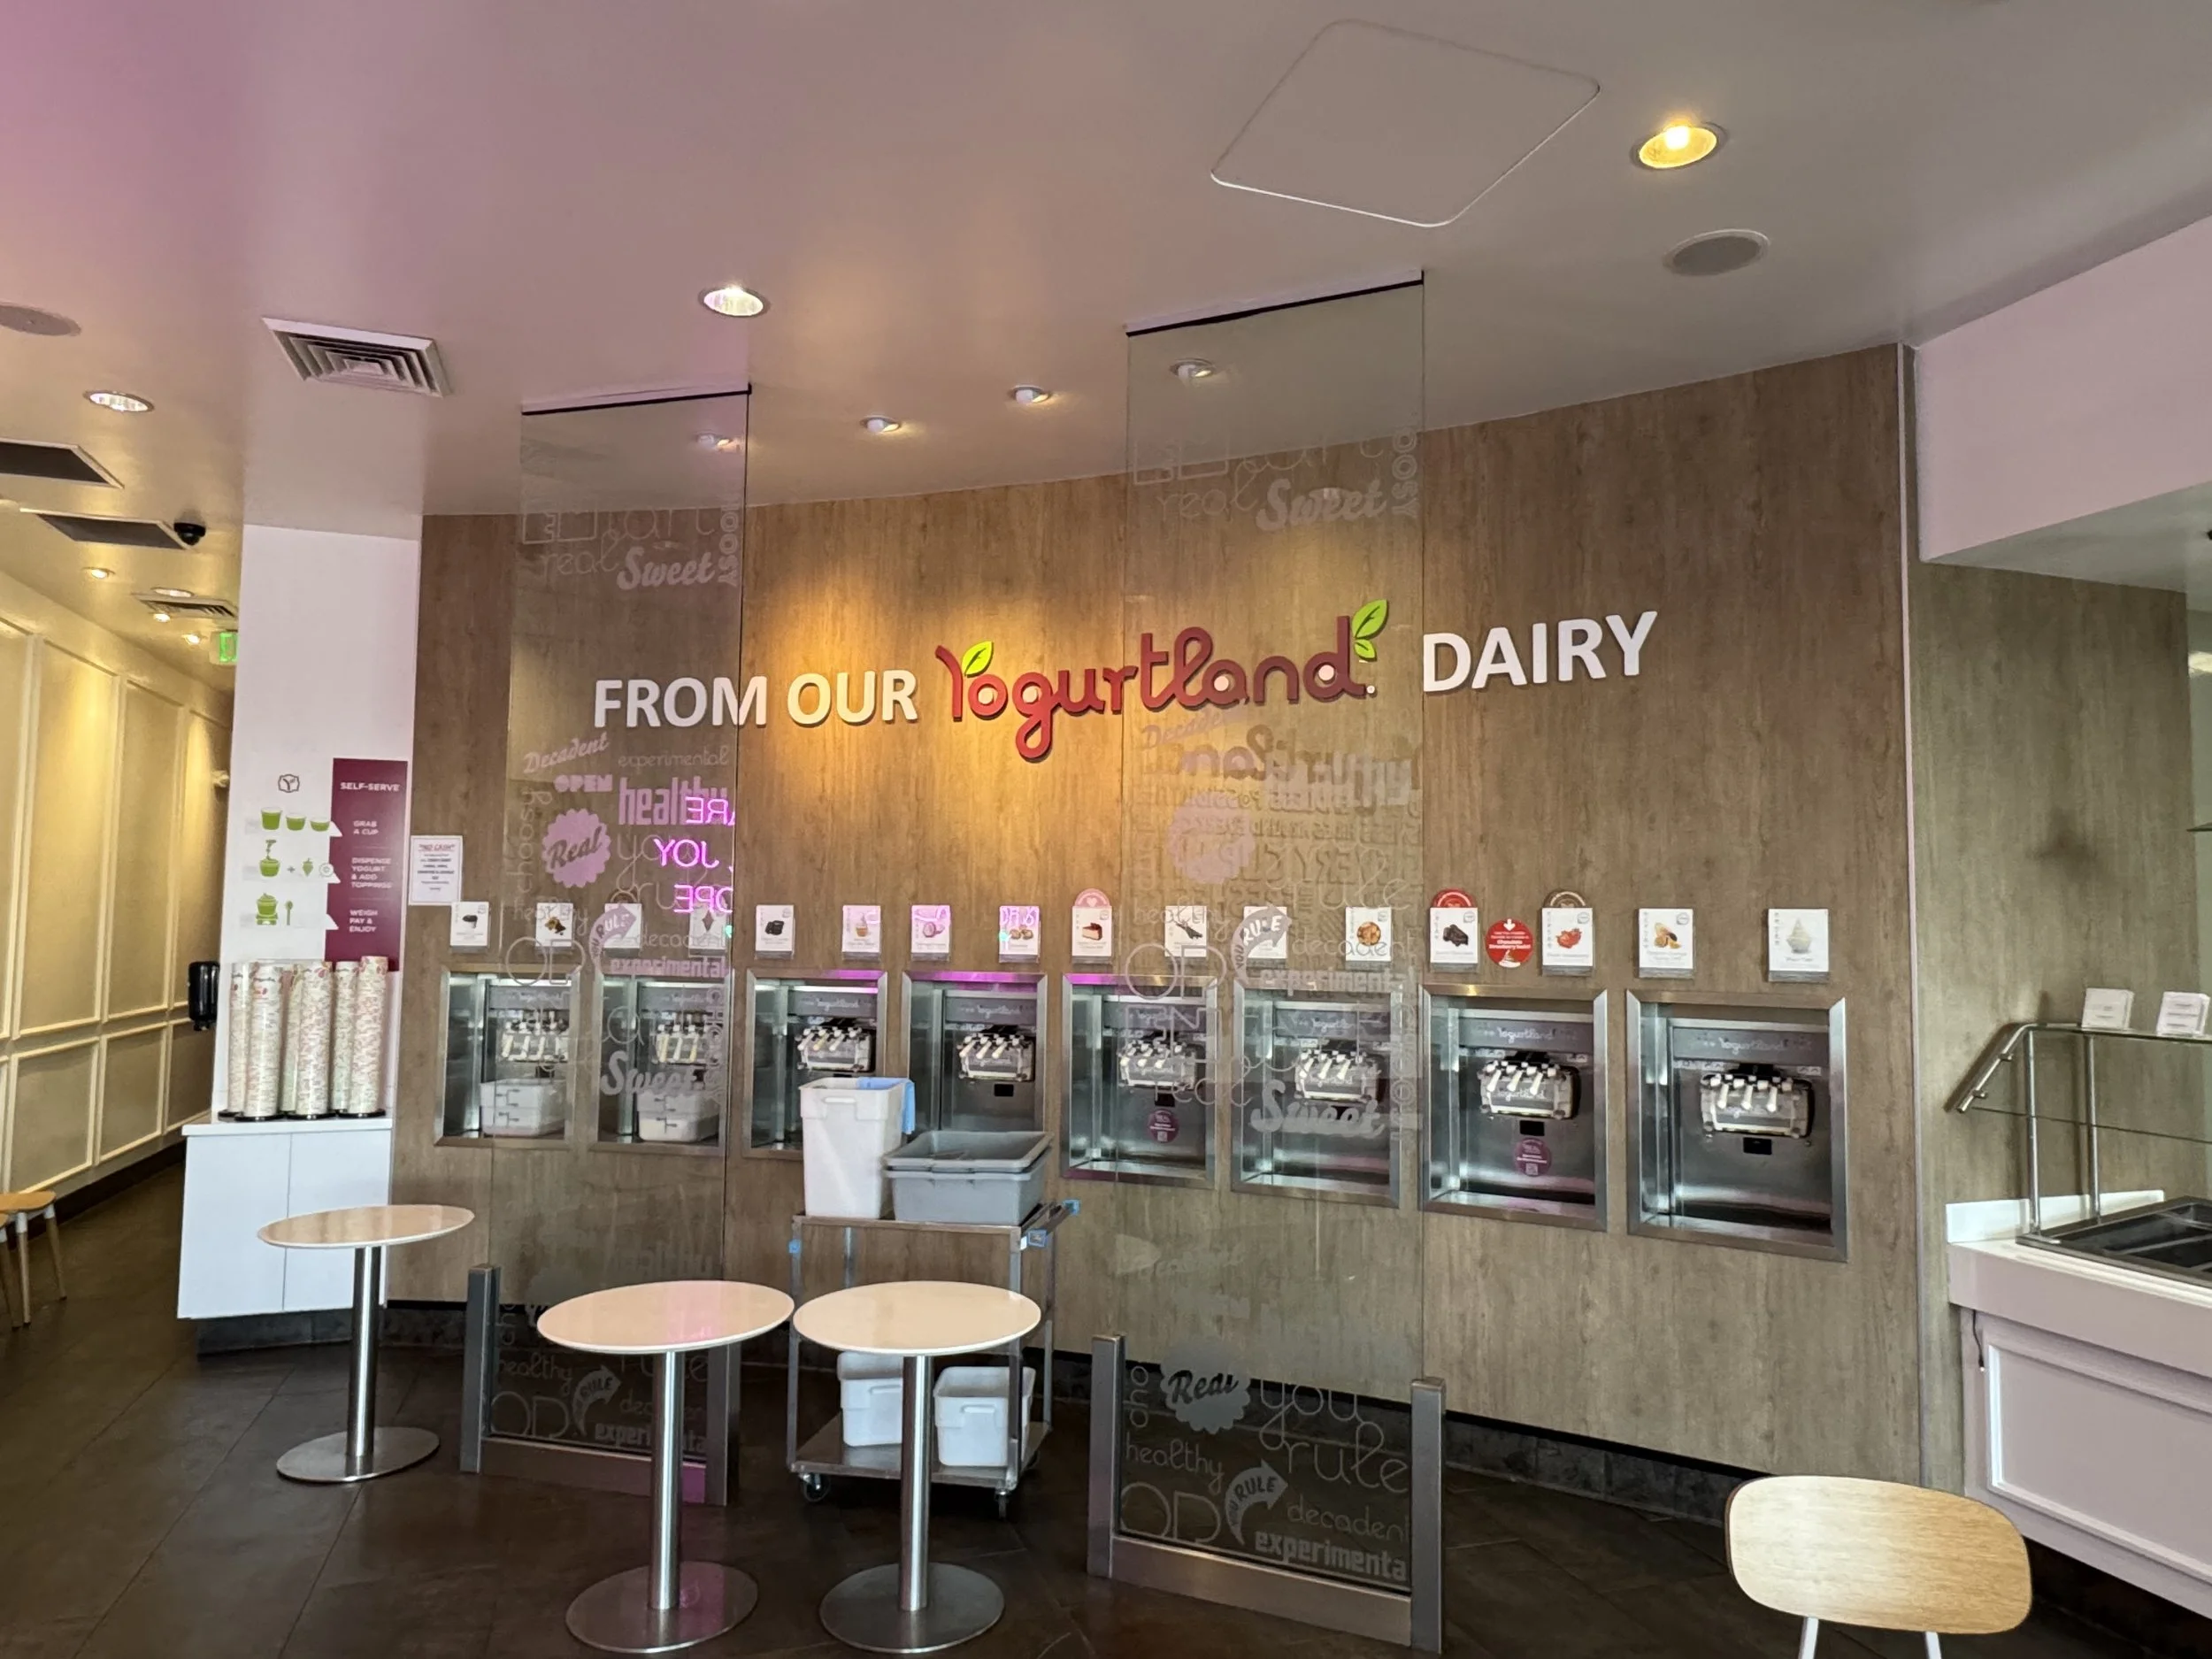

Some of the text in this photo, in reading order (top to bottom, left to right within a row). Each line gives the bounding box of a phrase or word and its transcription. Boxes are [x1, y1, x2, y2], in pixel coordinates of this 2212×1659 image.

[1256, 479, 1386, 532] Sweet
[617, 546, 715, 590] Sweet
[594, 675, 768, 729] FROM
[787, 670, 918, 726] OUR
[1423, 611, 1658, 693] DAIRY
[523, 733, 611, 773] Decadent
[618, 746, 729, 772] experimental
[340, 782, 400, 792] SELF-SERVE
[547, 826, 603, 869] Real
[1125, 1431, 1225, 1496] healthy
[1233, 1475, 1278, 1502] RULE
